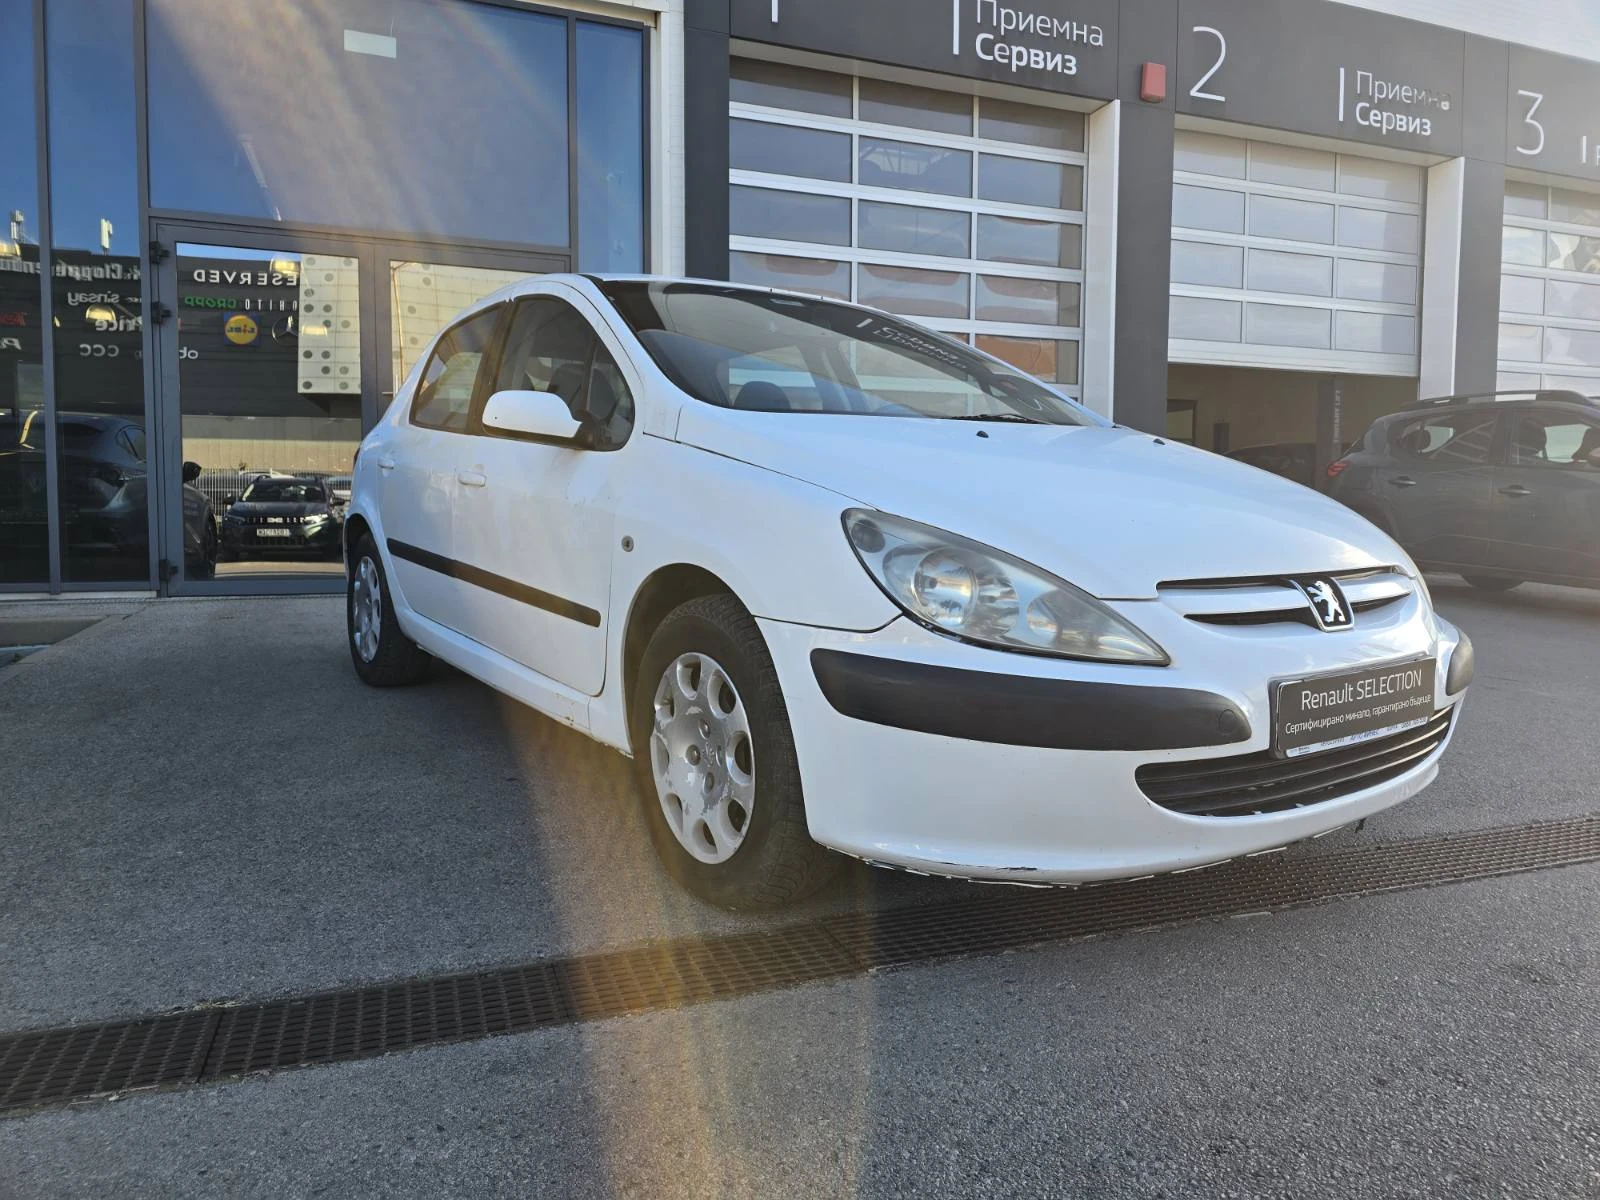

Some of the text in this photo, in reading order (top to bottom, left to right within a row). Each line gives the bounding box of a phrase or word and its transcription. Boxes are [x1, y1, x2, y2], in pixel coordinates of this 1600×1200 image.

[976, 0, 1104, 47] Приемна
[975, 33, 1078, 75] Сервиз
[1189, 26, 1226, 102] 2
[1355, 102, 1432, 136] Сервиз
[1515, 89, 1545, 156] 3
[1301, 668, 1422, 711] Renault SELECTION
[1286, 715, 1344, 734] Сертифицирано
